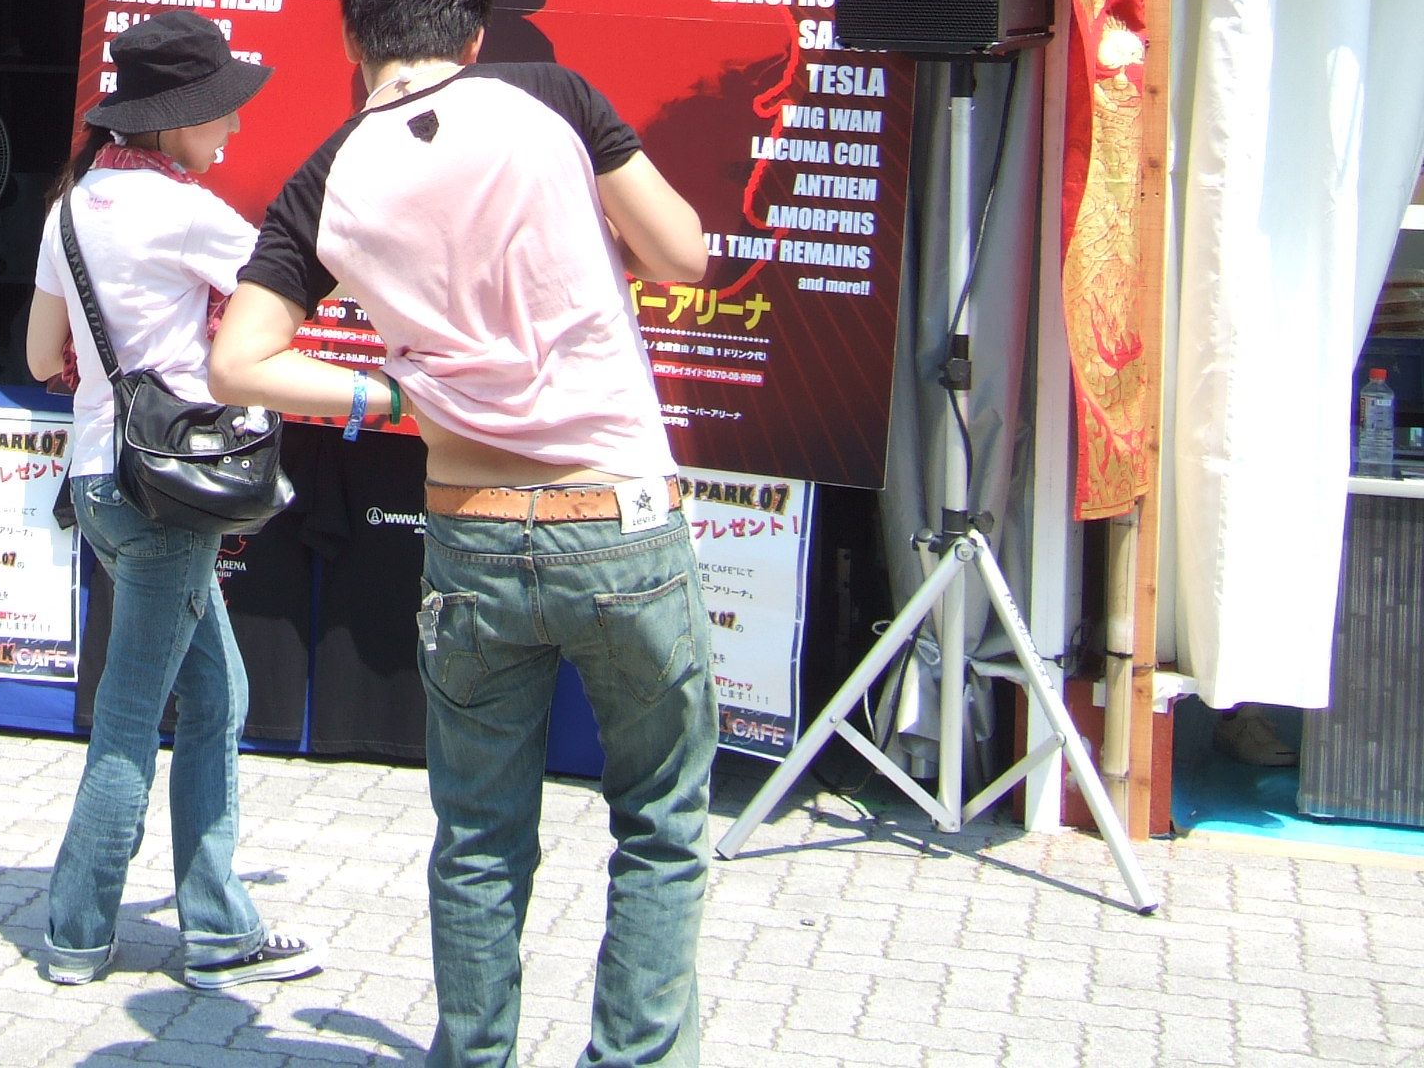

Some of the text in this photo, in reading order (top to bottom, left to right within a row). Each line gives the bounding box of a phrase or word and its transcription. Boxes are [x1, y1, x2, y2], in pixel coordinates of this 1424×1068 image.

[806, 63, 886, 98] TESLA
[782, 104, 882, 133] WIG WAM
[751, 136, 880, 168] LACUNA COIL
[793, 173, 878, 202] ANTHEM
[766, 205, 875, 236] AMORPHIS
[702, 232, 871, 269] LL THAT REMAINS
[797, 275, 871, 296] and more!!
[40, 429, 69, 457] 07
[694, 478, 756, 508] PARK
[758, 483, 791, 515] 07
[691, 514, 801, 539] プレゼント!
[1, 552, 17, 567] 07
[215, 559, 247, 571] ARENA
[16, 646, 69, 669] CAFE
[731, 717, 786, 747] CAFE
